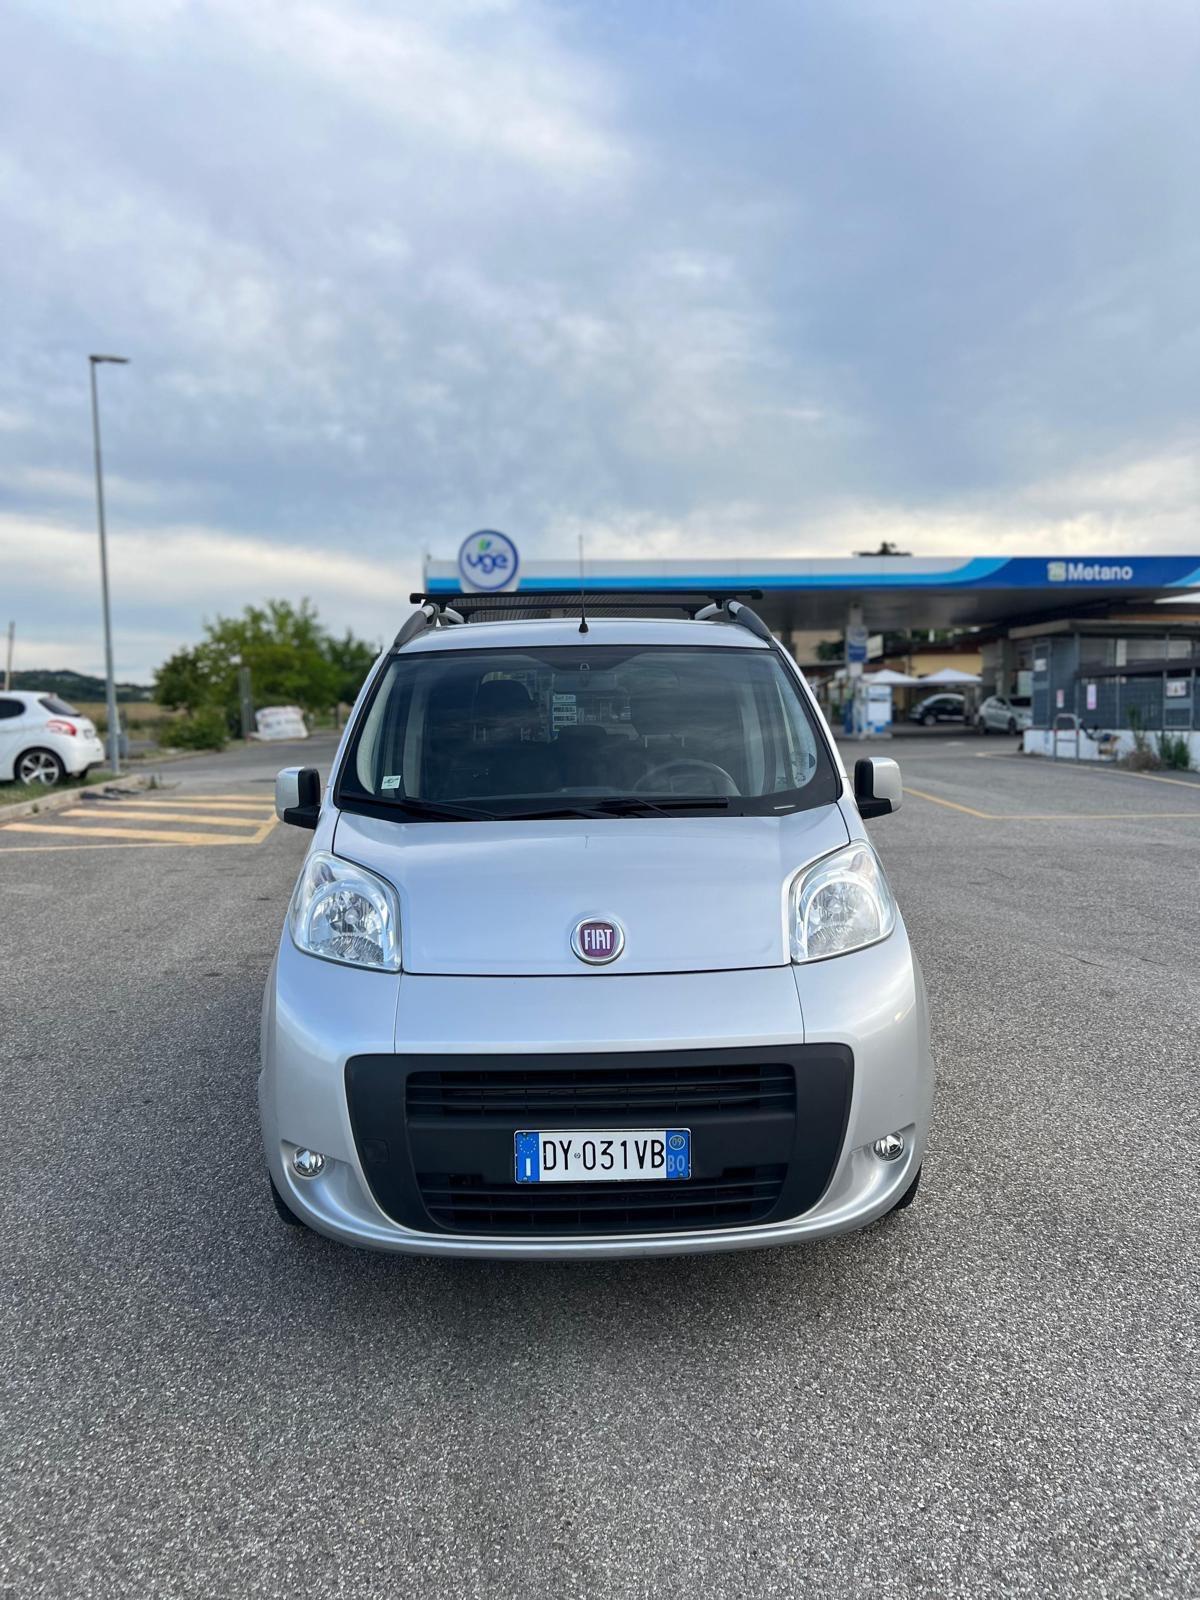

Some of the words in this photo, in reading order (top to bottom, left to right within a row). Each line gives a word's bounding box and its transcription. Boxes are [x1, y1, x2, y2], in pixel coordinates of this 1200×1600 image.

[1068, 562, 1133, 581] Metano
[583, 929, 613, 950] FIAT
[667, 1154, 686, 1173] BO
